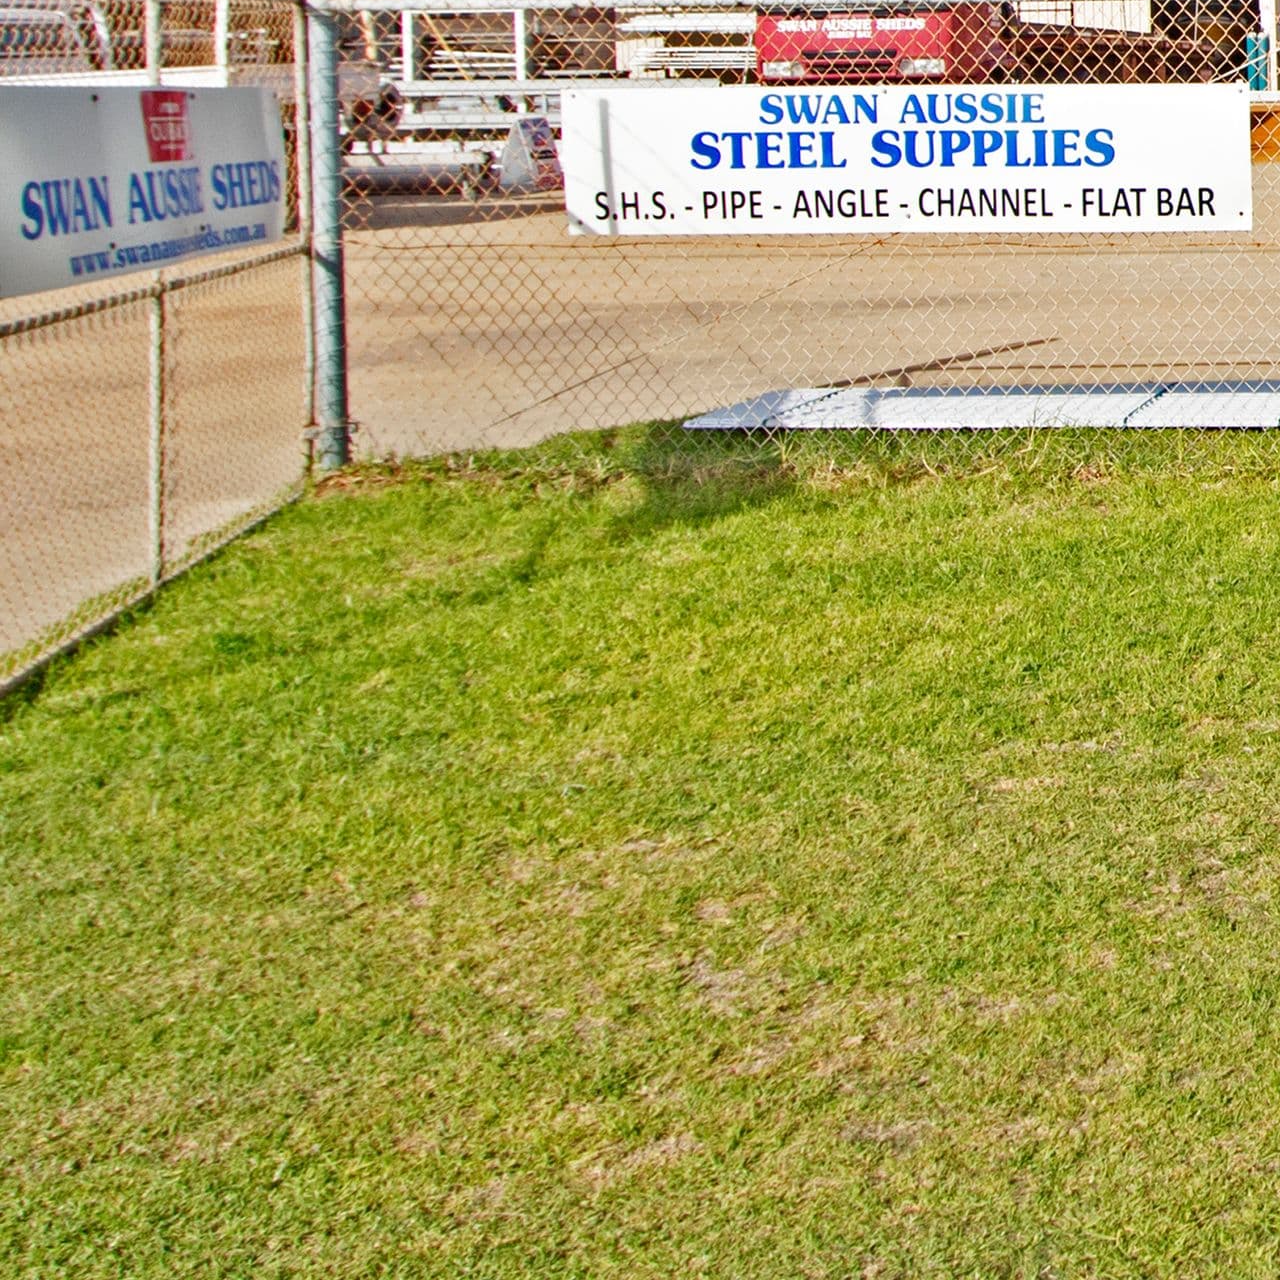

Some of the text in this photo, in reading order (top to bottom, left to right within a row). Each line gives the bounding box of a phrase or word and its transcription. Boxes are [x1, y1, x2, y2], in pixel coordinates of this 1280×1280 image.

[777, 18, 926, 32] SWAN AUSSIE SHEDS
[759, 93, 1045, 125] SWAN AUSSIE
[689, 128, 1116, 171] STEEL SUPPLIES
[21, 160, 280, 240] SWAN AUSSIE SHEDS
[595, 191, 676, 221] S.H.S.
[702, 190, 763, 220] PIPE
[792, 189, 890, 219] ANGLE
[918, 188, 1054, 218] CHANNEL
[1081, 188, 1147, 217] FLAT
[1157, 187, 1216, 217] BAR
